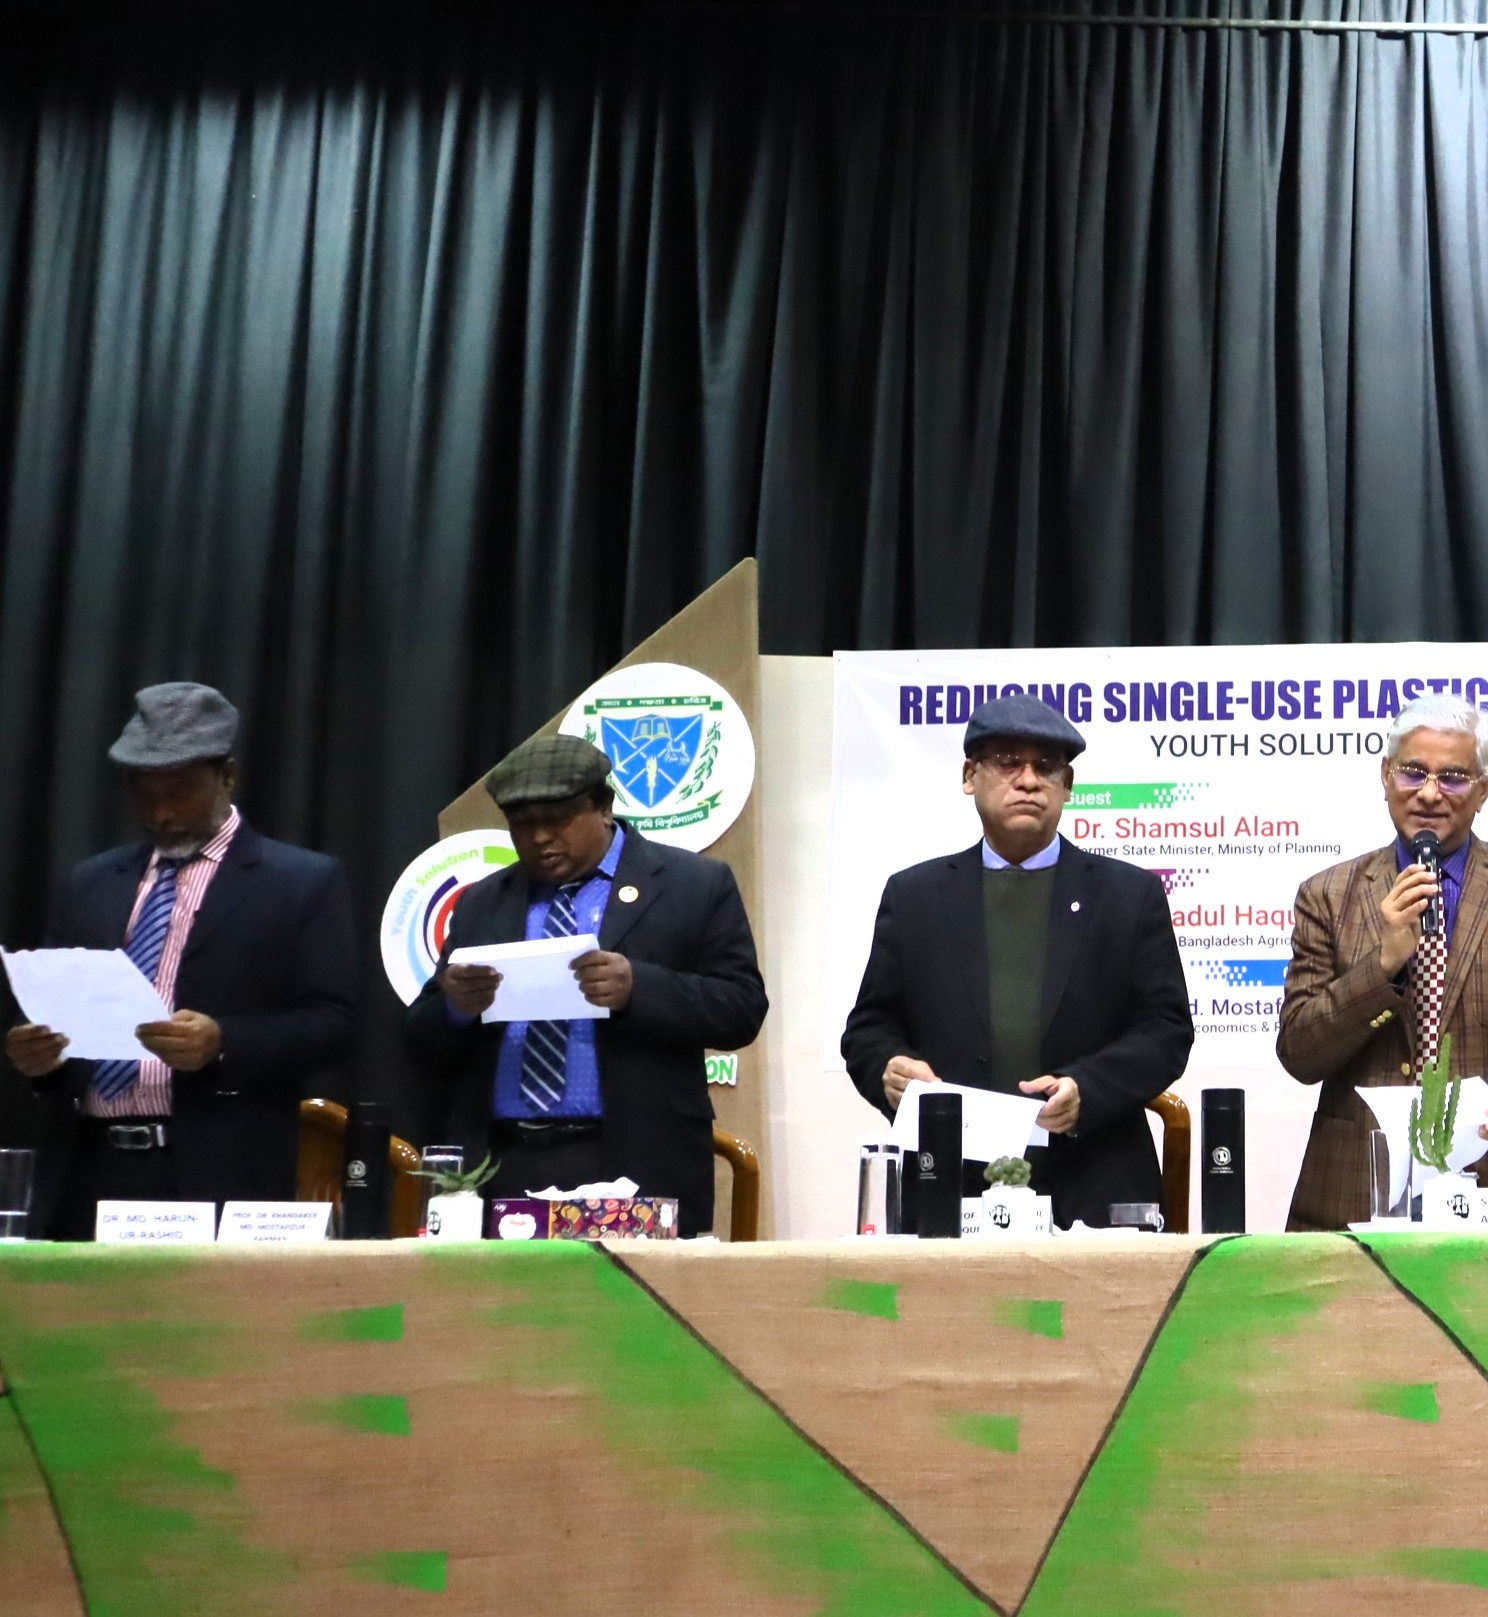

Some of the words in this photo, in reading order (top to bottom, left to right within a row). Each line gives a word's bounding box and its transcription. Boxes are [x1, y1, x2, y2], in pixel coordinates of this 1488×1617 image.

[899, 682, 1092, 725] REDNG
[1103, 679, 1322, 723] SINGLE-USE
[1150, 734, 1249, 757] YOUTH
[1259, 732, 1389, 756] SOLUTIO
[1074, 818, 1105, 839] Dr.
[1115, 816, 1225, 839] Shamsul
[1234, 815, 1299, 838] Alam
[1122, 844, 1156, 856] State
[1160, 843, 1214, 857] Minister,
[1217, 843, 1265, 858] Ministy
[1268, 842, 1284, 855] of
[1285, 841, 1341, 857] Planning
[390, 888, 418, 936] Youth
[415, 848, 479, 887] Solution
[1172, 904, 1225, 927] adul
[1178, 935, 1254, 949] Bangladesh
[1212, 997, 1283, 1016] Mostaf
[1194, 1023, 1257, 1033] conomics
[1261, 1022, 1270, 1032] &
